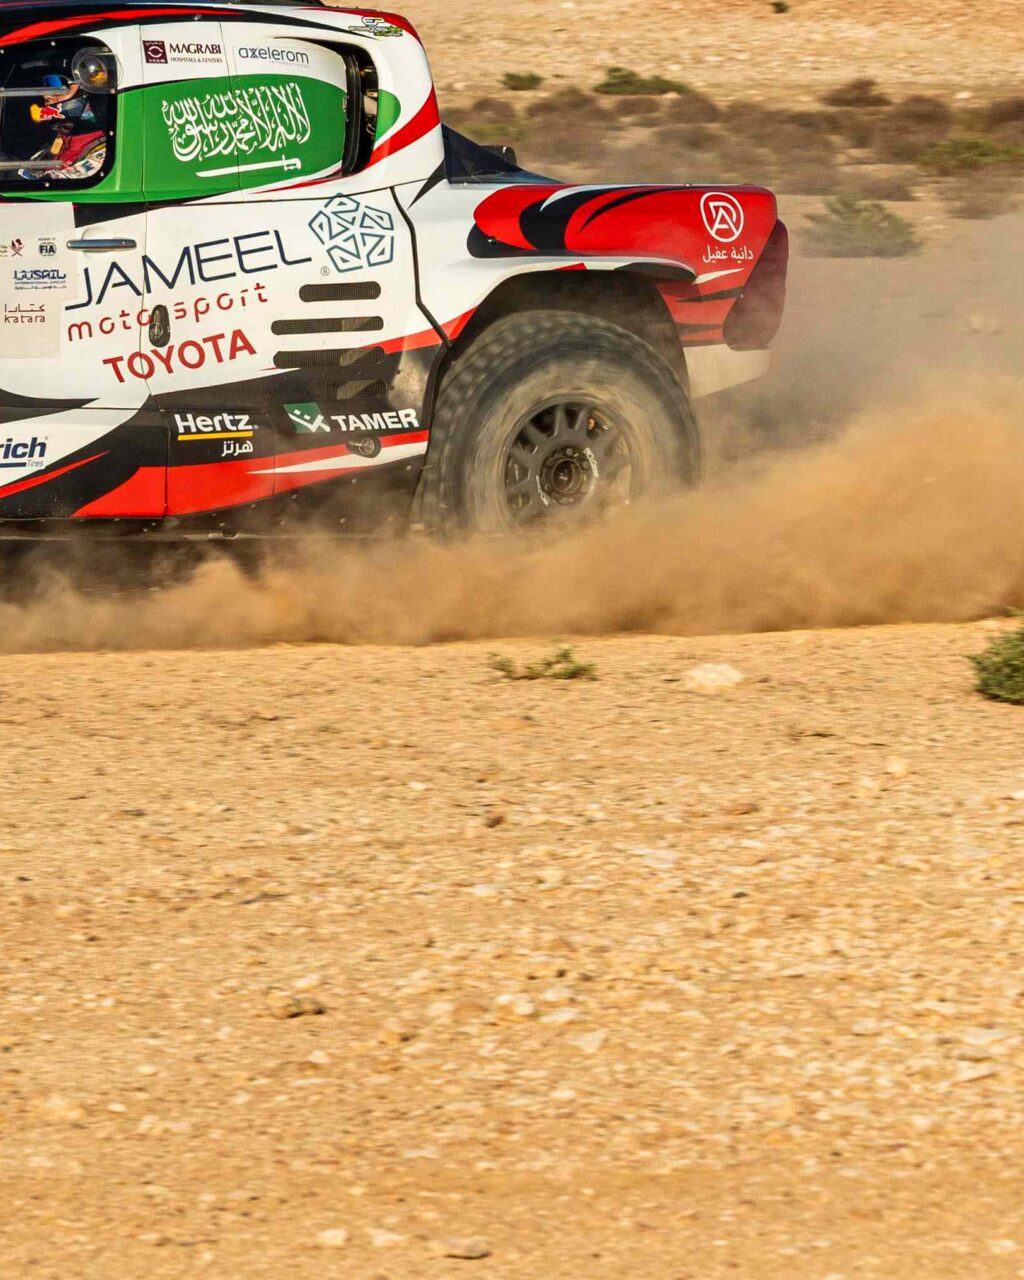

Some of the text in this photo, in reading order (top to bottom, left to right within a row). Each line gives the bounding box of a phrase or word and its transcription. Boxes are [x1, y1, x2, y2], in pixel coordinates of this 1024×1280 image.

[169, 43, 222, 54] MAGRABI
[238, 46, 309, 64] axelerom
[64, 229, 312, 311] JAMEEL
[4, 315, 46, 323] katara
[68, 282, 268, 342] motosport
[102, 328, 257, 384] TOYOTA
[174, 412, 253, 434] Hertz
[330, 408, 420, 433] TAMER
[221, 439, 254, 457] هرتز
[26, 459, 45, 468] Tires
